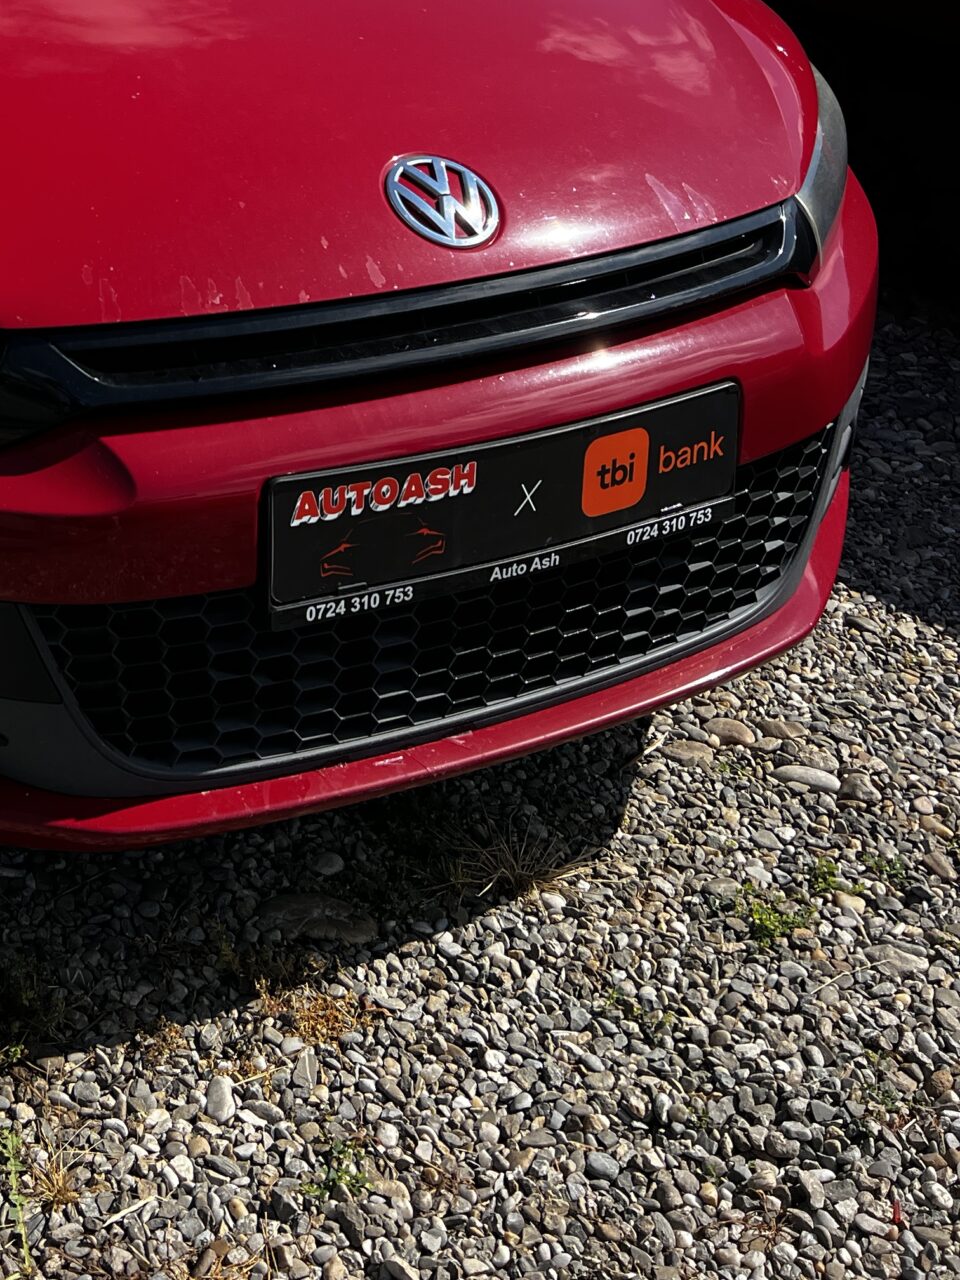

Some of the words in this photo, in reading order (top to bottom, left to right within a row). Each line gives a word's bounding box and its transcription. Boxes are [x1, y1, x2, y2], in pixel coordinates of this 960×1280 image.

[385, 155, 500, 248] VW
[290, 461, 478, 527] AUTOASH
[597, 452, 636, 490] tbi
[658, 431, 725, 474] bank
[626, 524, 659, 545] 0724
[662, 515, 685, 535] 310
[689, 508, 712, 527] 753
[489, 564, 527, 582] Auto
[529, 553, 560, 572] Ash
[306, 600, 346, 622] 0724
[350, 592, 380, 614] 310
[385, 586, 414, 606] 753
